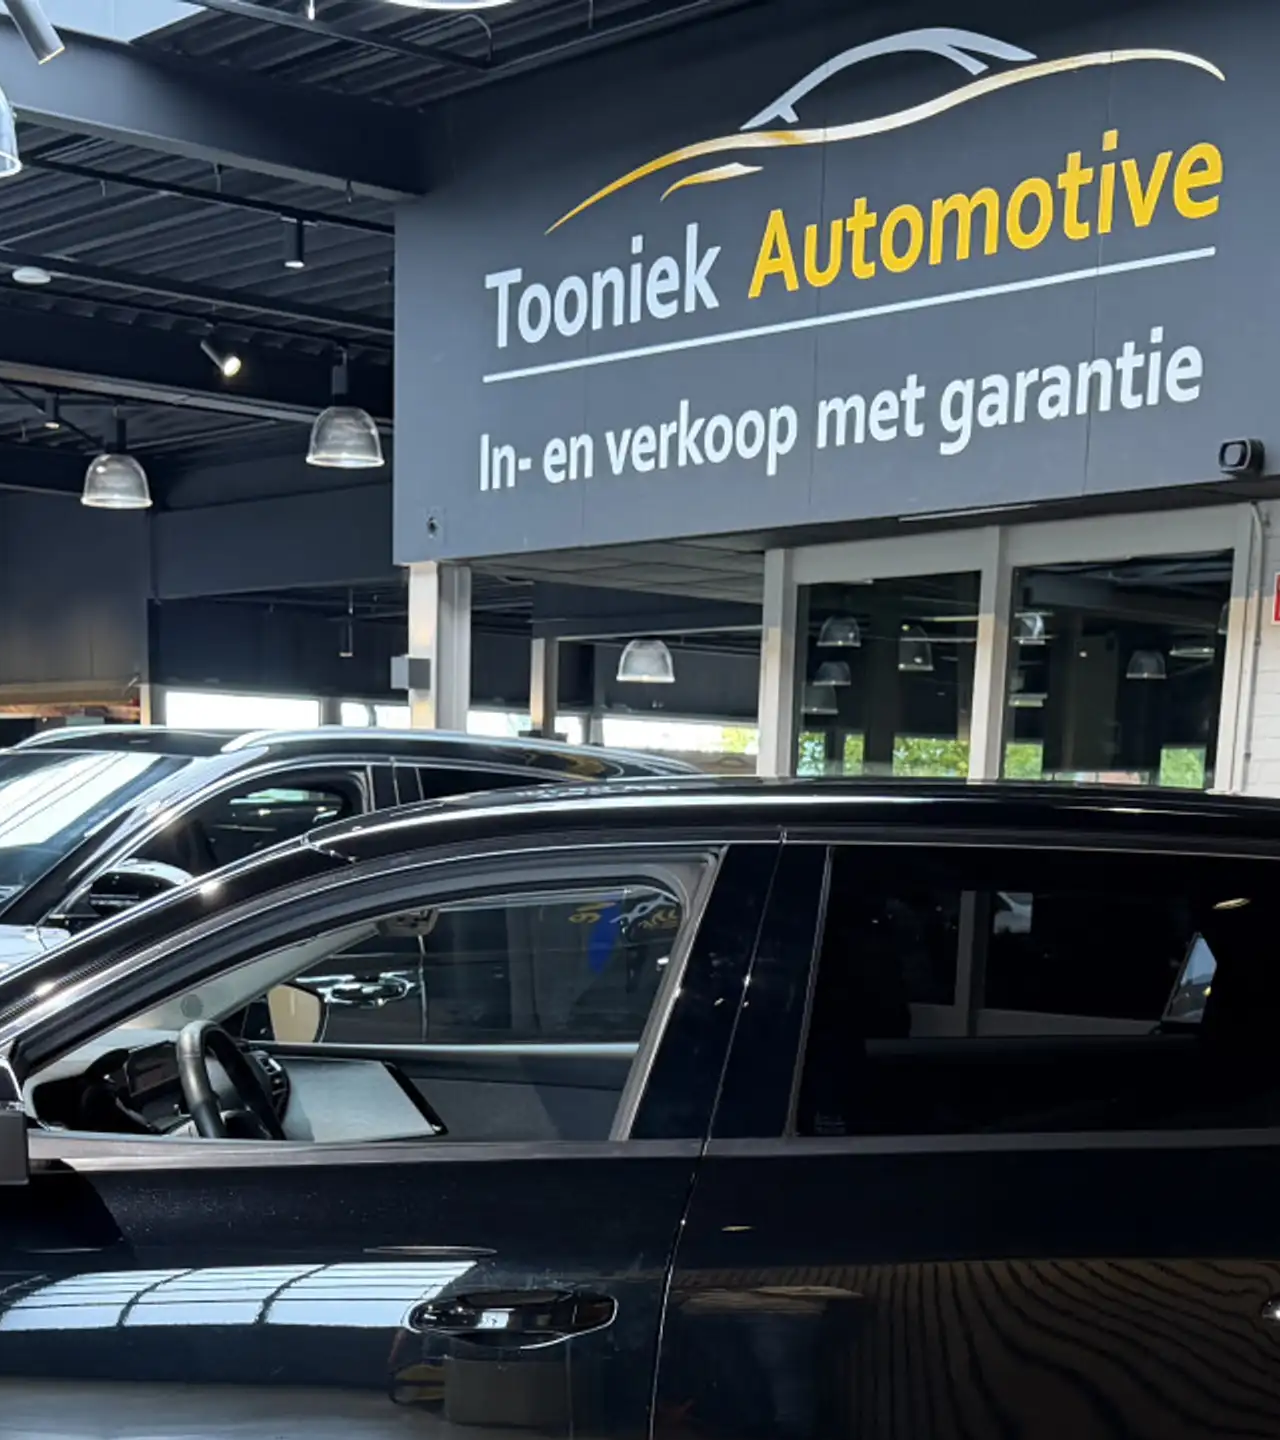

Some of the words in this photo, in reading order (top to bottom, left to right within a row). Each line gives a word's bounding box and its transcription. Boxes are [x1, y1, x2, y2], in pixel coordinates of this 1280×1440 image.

[485, 223, 721, 348] Tooniek
[748, 130, 1224, 300] Automotive
[480, 433, 532, 492] In-
[543, 434, 594, 484] en
[605, 399, 798, 477] verkoop
[816, 373, 926, 449] met
[938, 326, 1204, 456] garantie
